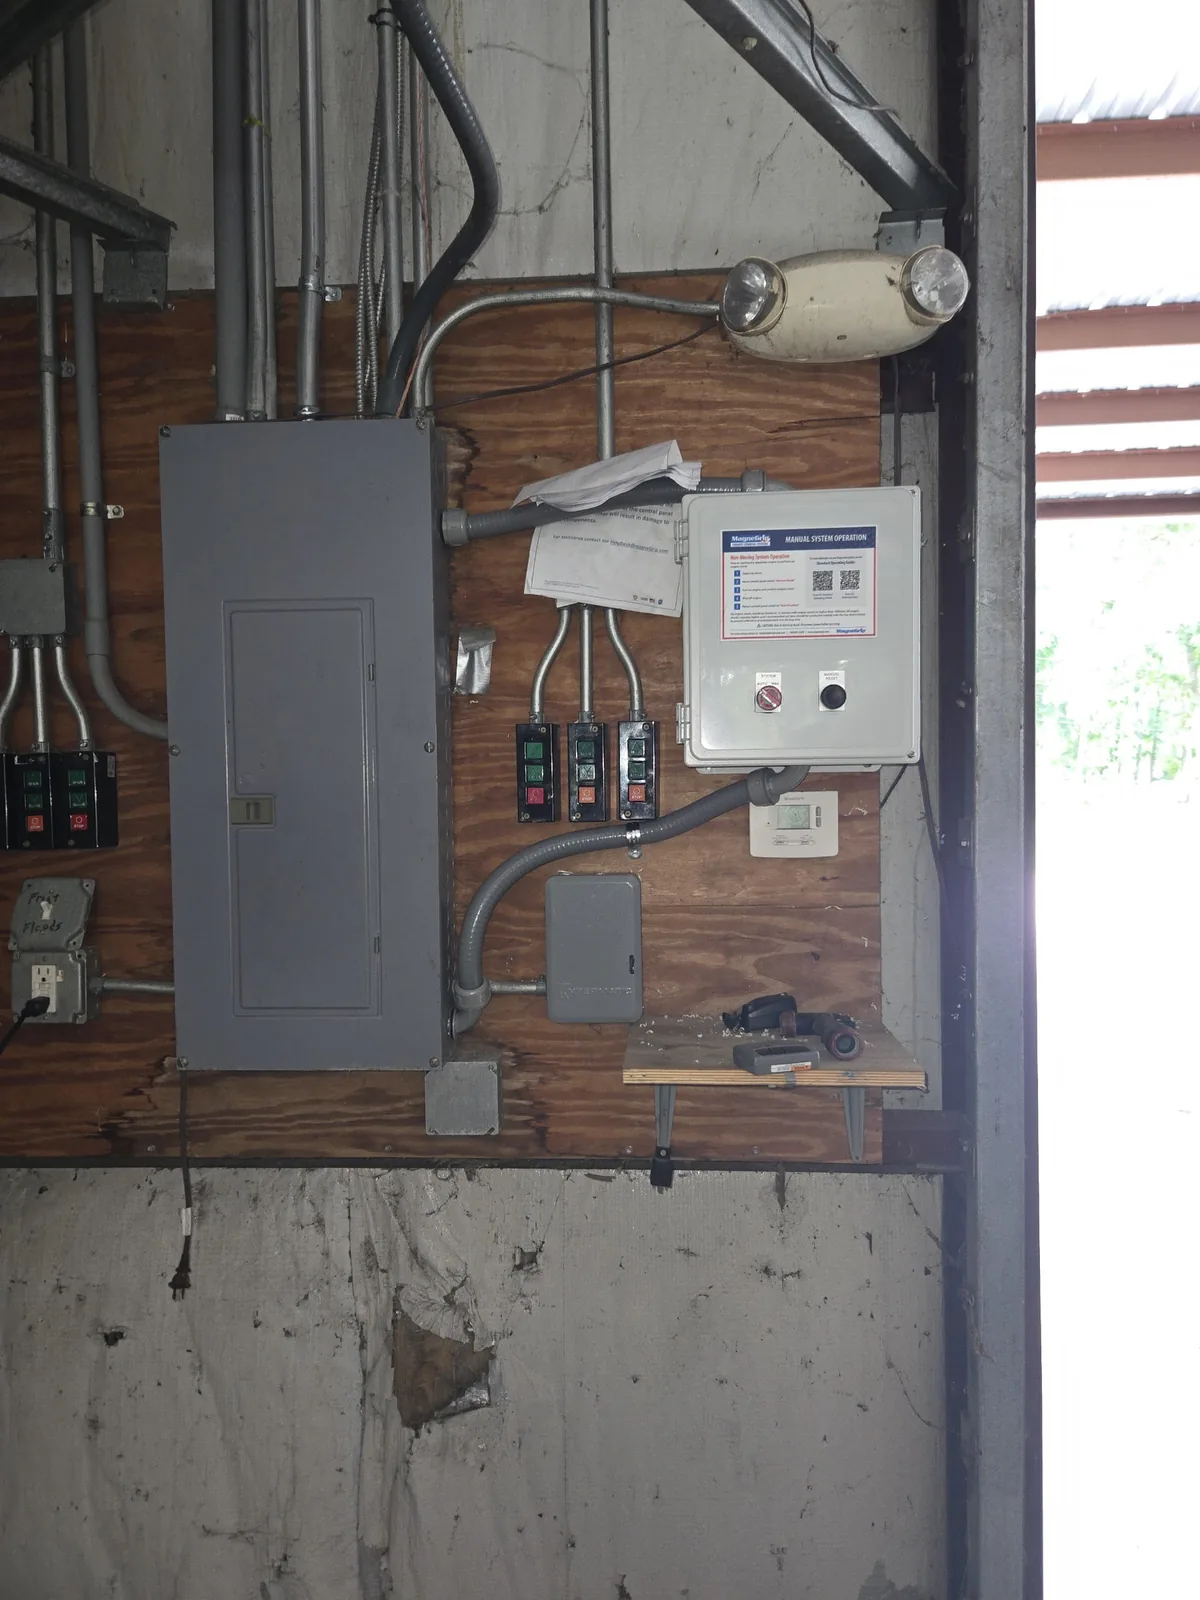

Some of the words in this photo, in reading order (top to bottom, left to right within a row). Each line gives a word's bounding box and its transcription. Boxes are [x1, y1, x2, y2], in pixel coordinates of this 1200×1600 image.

[642, 516, 663, 524] damage
[785, 535, 810, 543] MANUAL
[811, 534, 833, 543] SYSTEM
